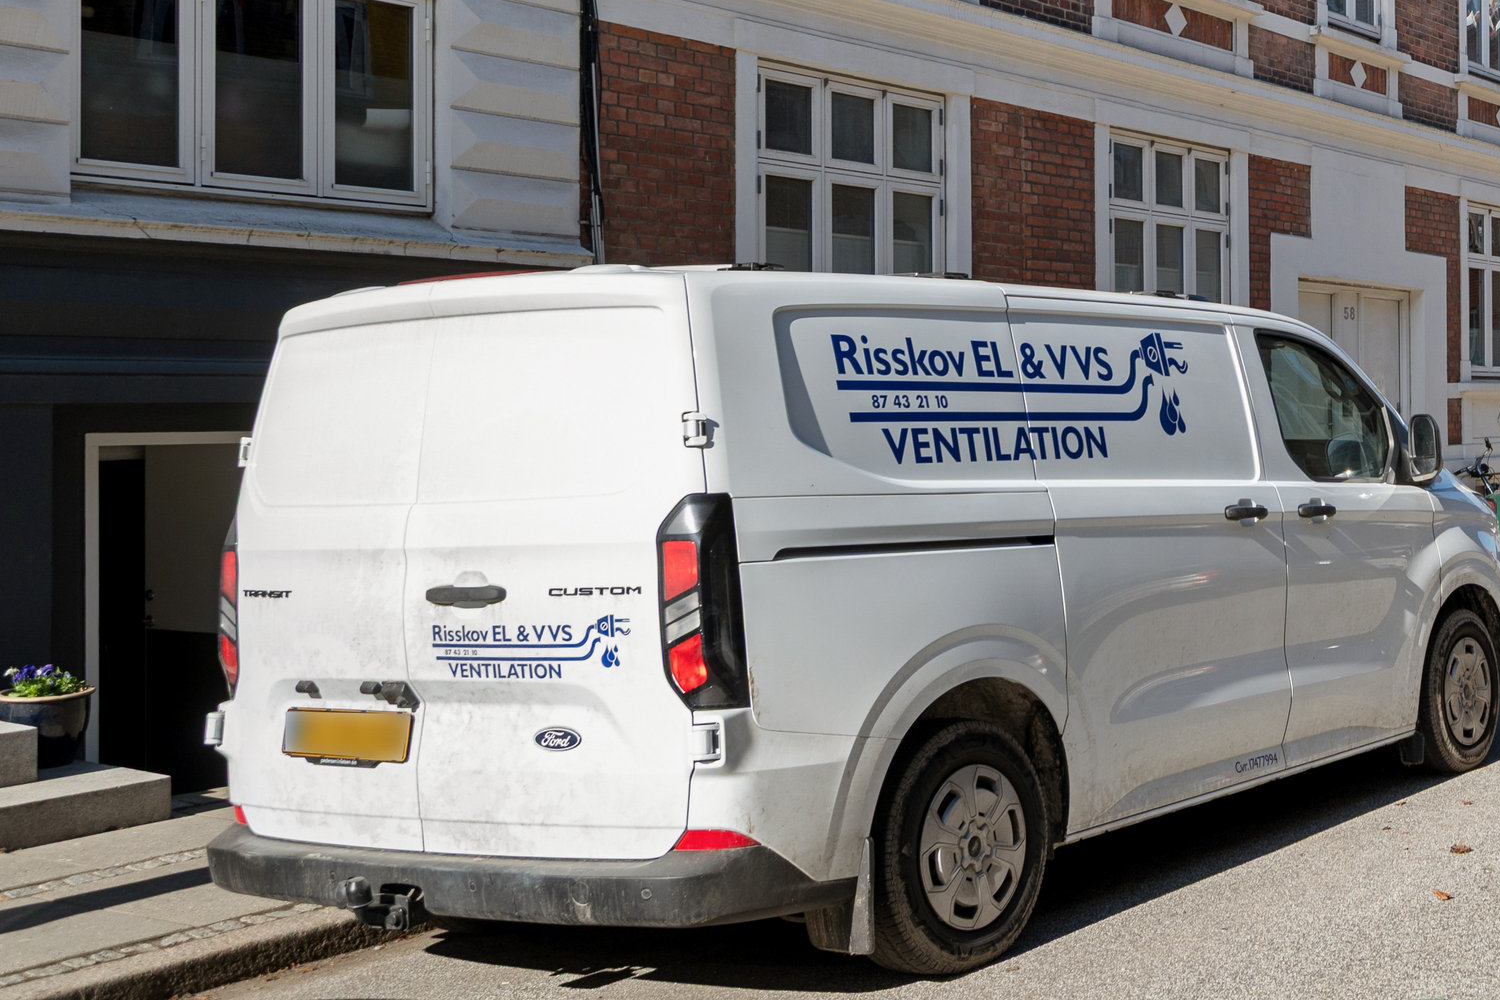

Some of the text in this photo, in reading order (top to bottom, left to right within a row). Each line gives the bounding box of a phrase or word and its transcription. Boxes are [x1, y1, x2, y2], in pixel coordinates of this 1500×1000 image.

[1343, 306, 1356, 320] 58
[830, 334, 1114, 382] Risskov EL & VVS
[871, 395, 949, 409] 87 43 21 10
[882, 426, 1109, 465] VENTILATION
[243, 589, 292, 599] TRANSIT
[548, 586, 642, 597] CUSTOM
[432, 625, 573, 642] Risskov EL & VVS
[448, 663, 562, 679] VENTILATION
[540, 731, 572, 748] Ford
